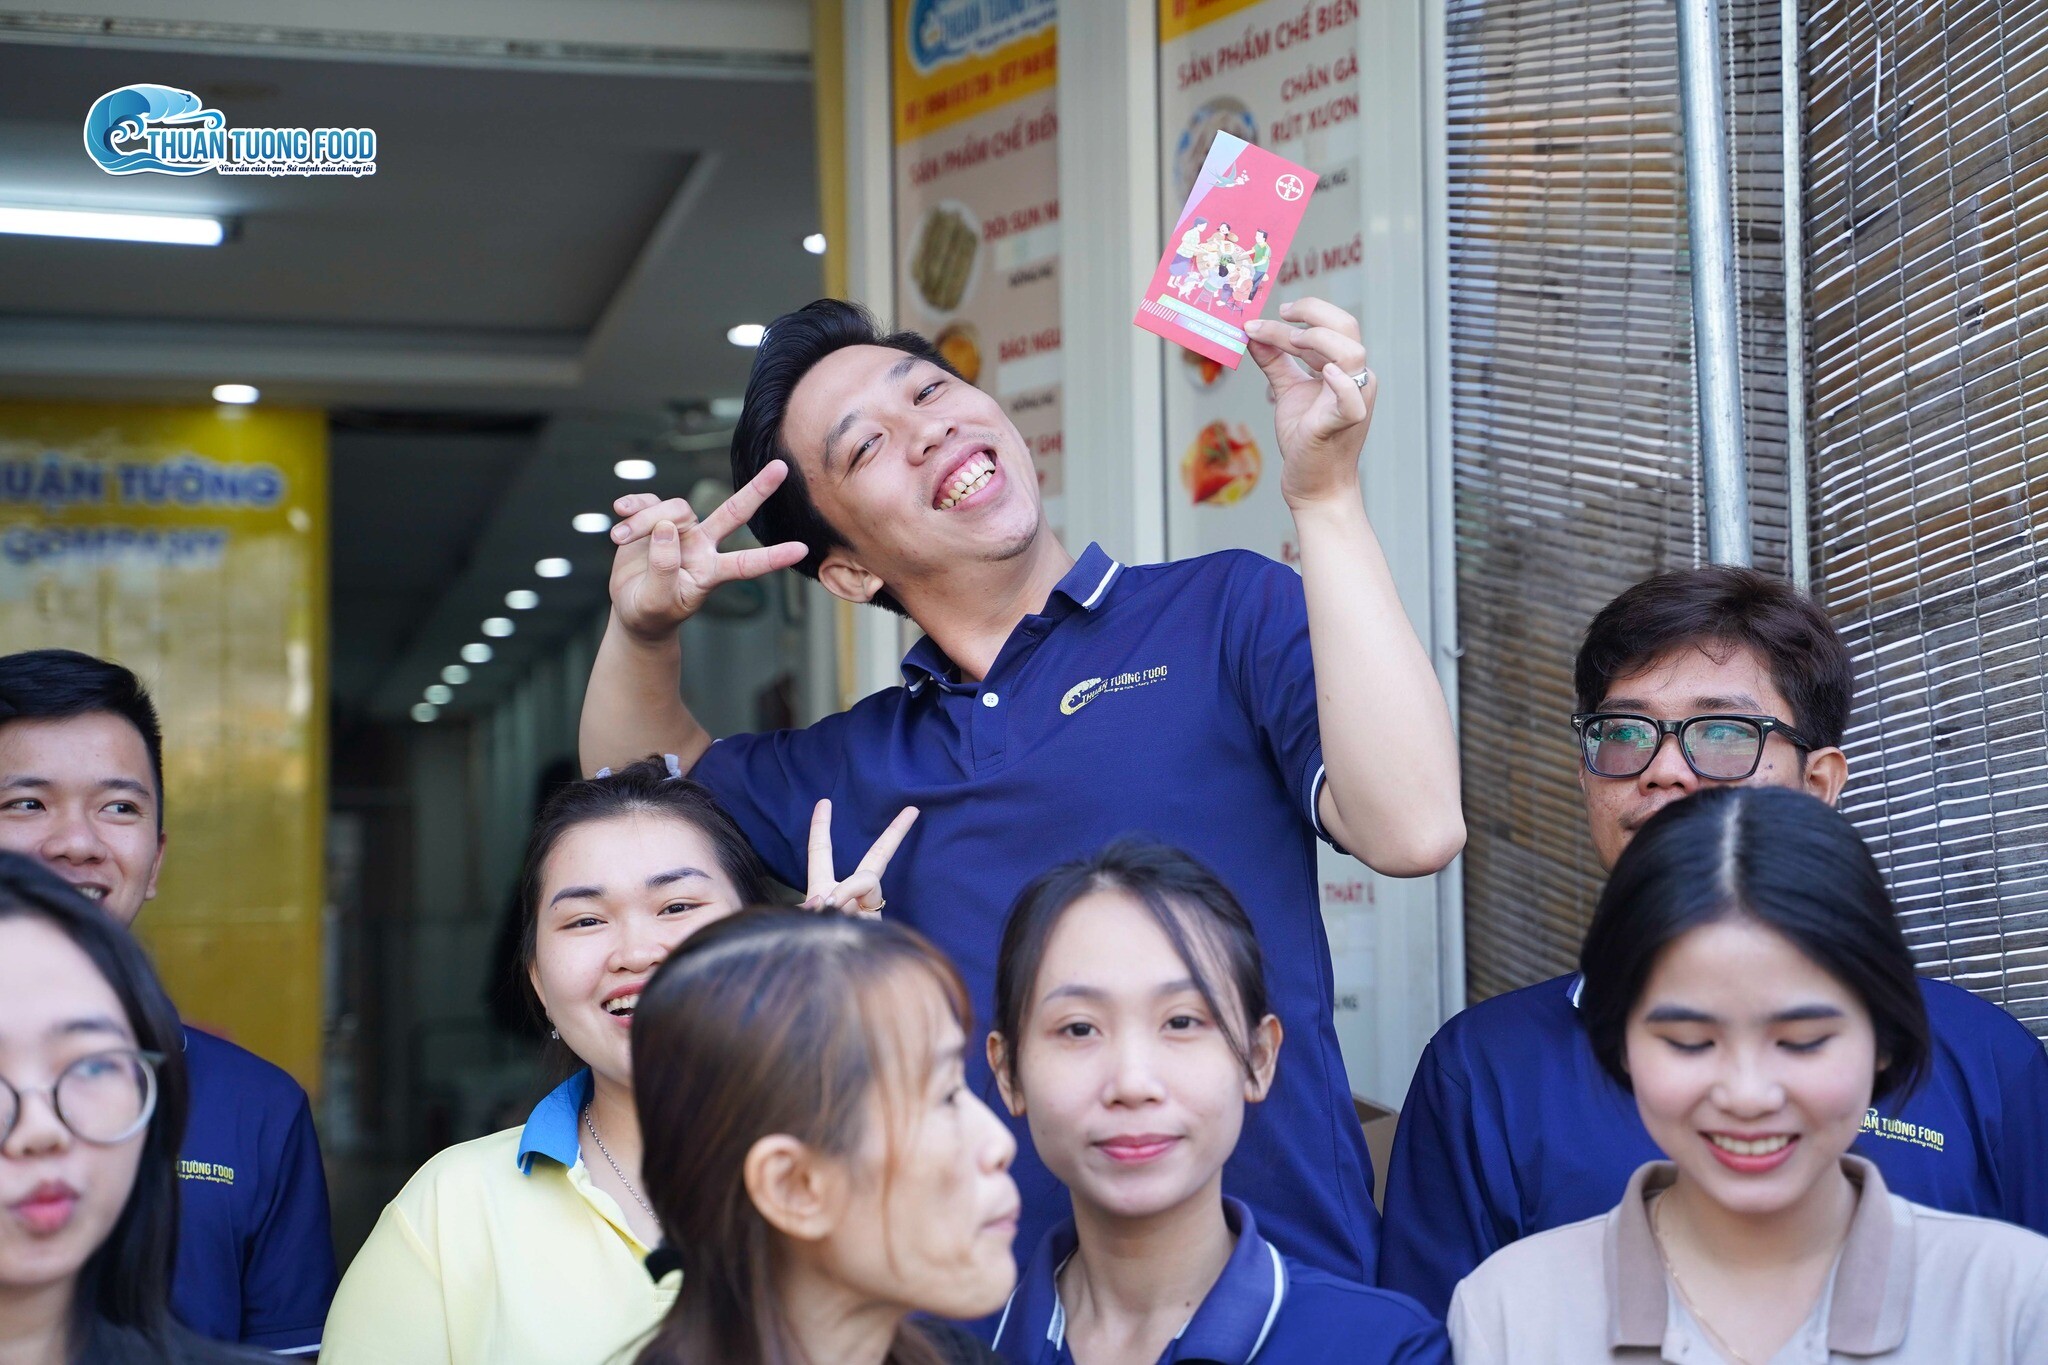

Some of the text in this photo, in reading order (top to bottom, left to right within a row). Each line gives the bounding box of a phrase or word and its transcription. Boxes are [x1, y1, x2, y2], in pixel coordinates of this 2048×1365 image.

[0, 452, 104, 511] UẬN
[1918, 1126, 1944, 1146] FOOD
[213, 1164, 234, 1180] FOOD
